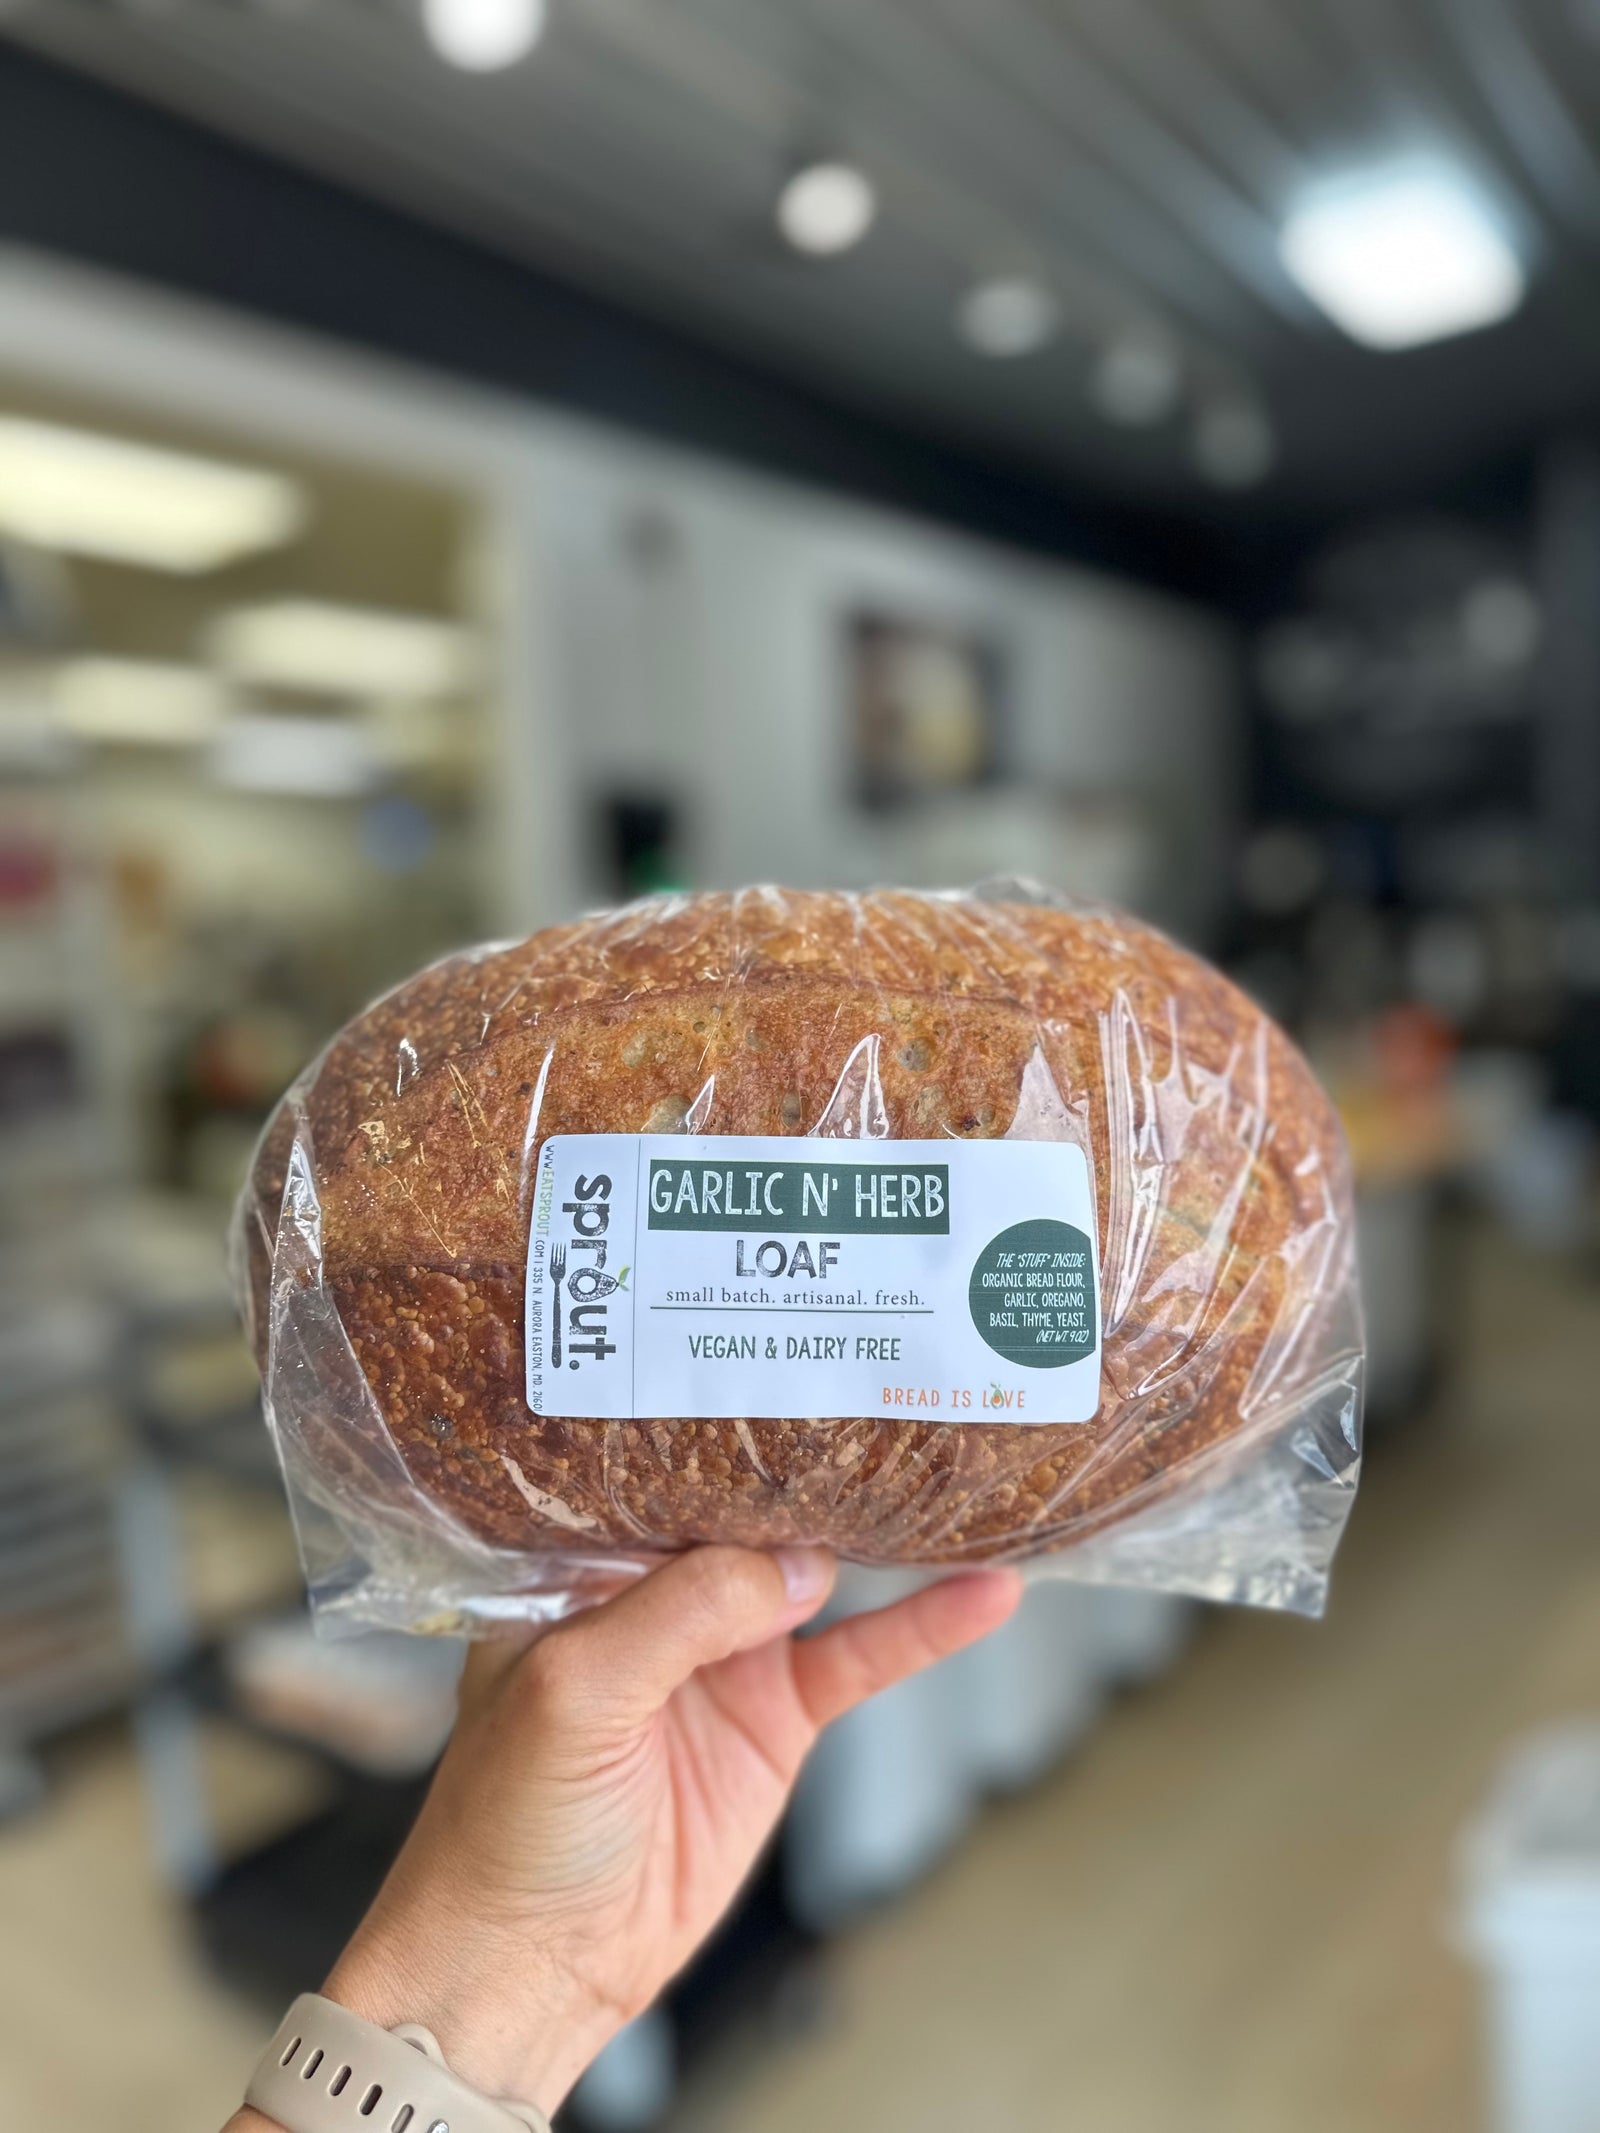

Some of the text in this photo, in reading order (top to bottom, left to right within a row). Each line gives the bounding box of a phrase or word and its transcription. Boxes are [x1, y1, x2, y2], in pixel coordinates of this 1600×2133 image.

[650, 1169, 945, 1218] GARLIC N' HERB
[736, 1239, 841, 1279] LOAF
[996, 1253, 1016, 1268] THE
[533, 1267, 544, 1287] 335
[982, 1272, 1086, 1289] ORGANIC BREAD FLOUR,
[665, 1286, 926, 1307] small batch. artisanal. fresh.
[1004, 1292, 1087, 1309] GARLIC, OREGANO,
[532, 1300, 543, 1334] AURORA
[989, 1312, 1087, 1328] BASIL, THYME, YEAST.
[531, 1336, 543, 1371] EASTON,
[688, 1335, 901, 1361] VEGAN & DAIRY FREE
[882, 1387, 941, 1407] BREAD
[951, 1389, 972, 1408] IS
